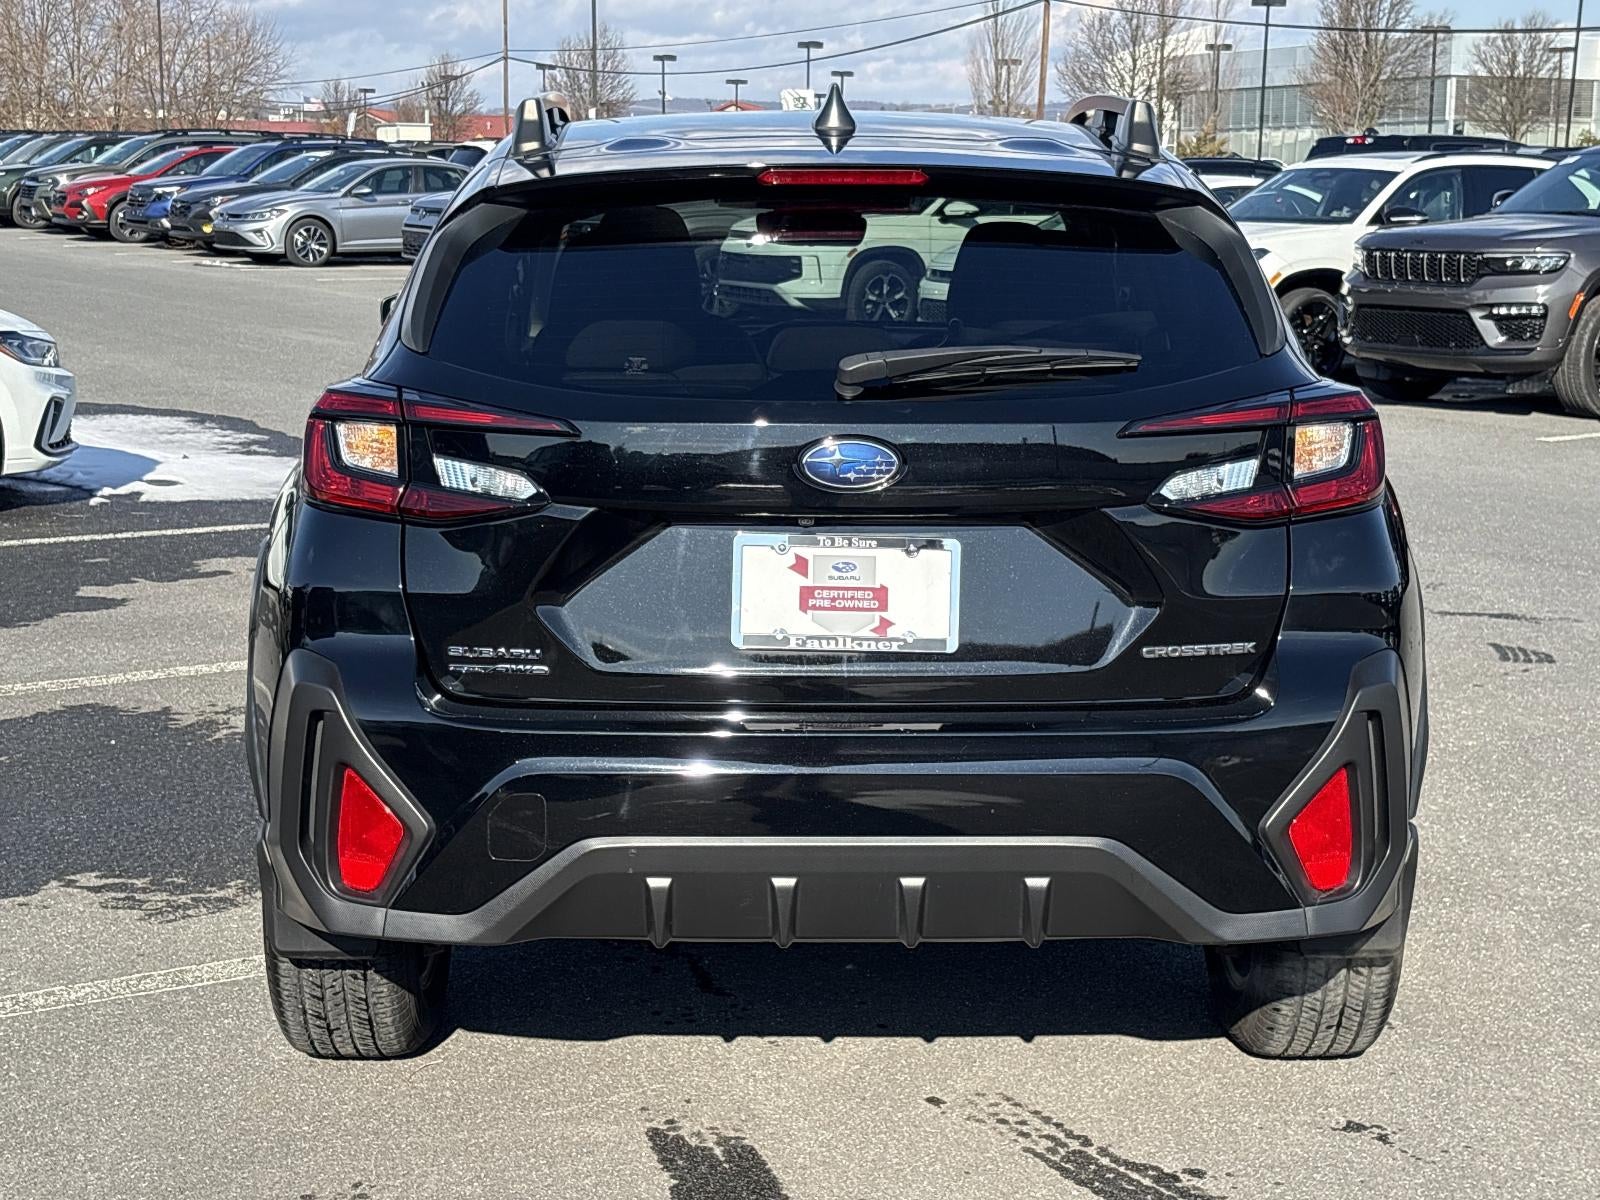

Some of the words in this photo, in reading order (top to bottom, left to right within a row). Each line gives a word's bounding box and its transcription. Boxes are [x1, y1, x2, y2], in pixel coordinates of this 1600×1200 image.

[817, 536, 832, 547] To
[835, 537, 849, 548] Be
[851, 538, 878, 548] Sure
[814, 589, 874, 599] CERTIFIED
[808, 599, 879, 609] PRE-OWNED
[788, 636, 905, 651] Faulkner
[447, 646, 542, 659] SUBARU
[1142, 642, 1256, 658] CROSSTREK
